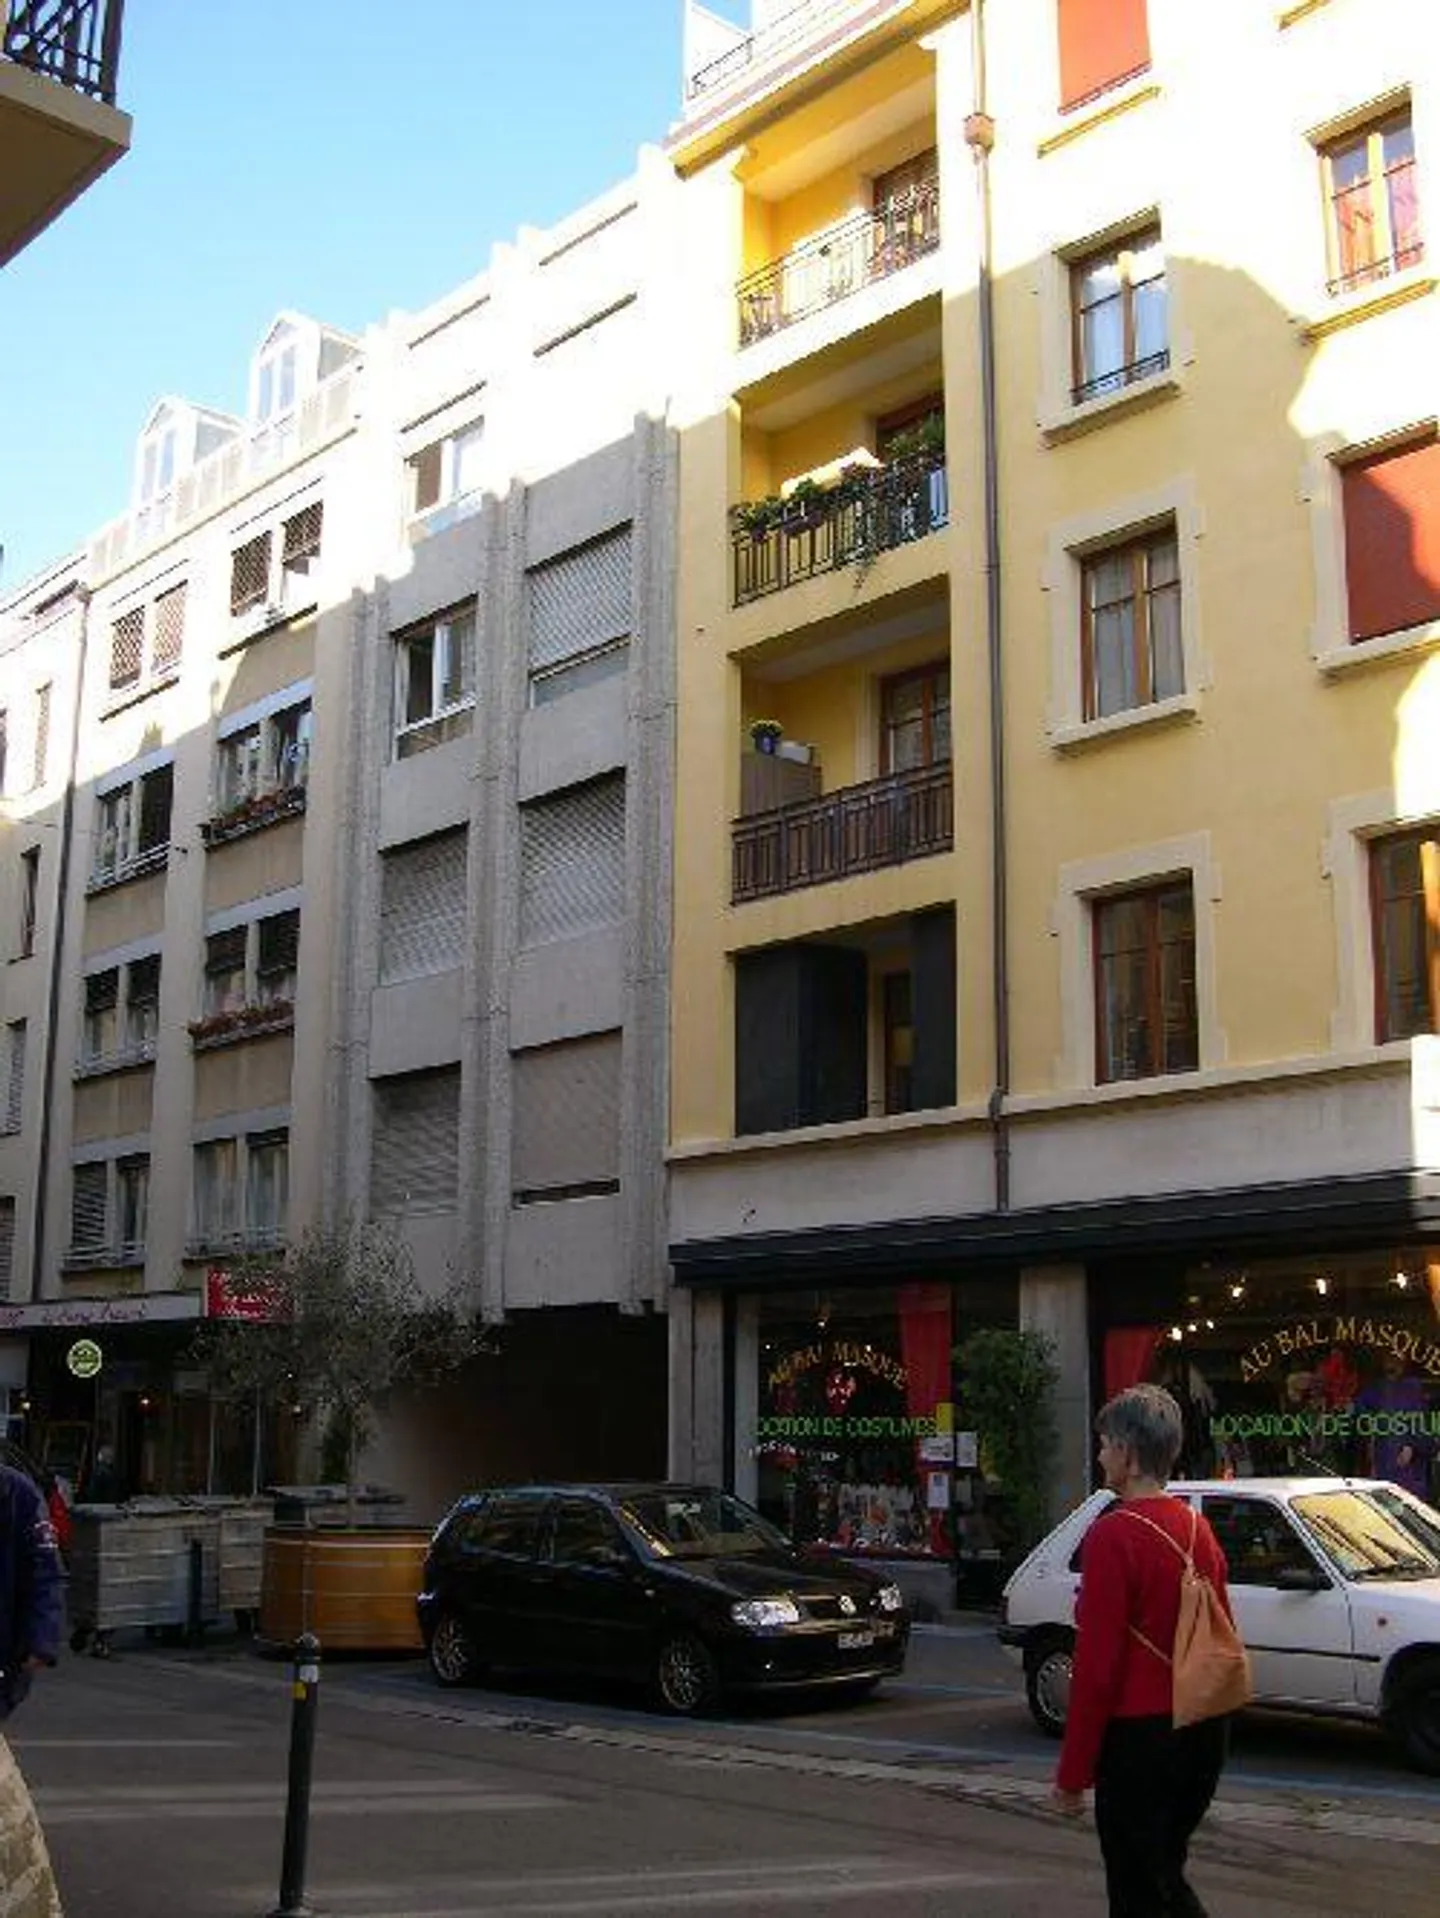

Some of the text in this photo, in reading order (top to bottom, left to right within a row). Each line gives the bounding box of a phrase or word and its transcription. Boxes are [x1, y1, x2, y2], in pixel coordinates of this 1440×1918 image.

[1240, 1341, 1273, 1384] AU
[1274, 1320, 1329, 1355] BAL
[755, 1416, 820, 1436] OCATION
[823, 1416, 843, 1436] DE
[1210, 1411, 1440, 1437] LOCATION DE COSTU
